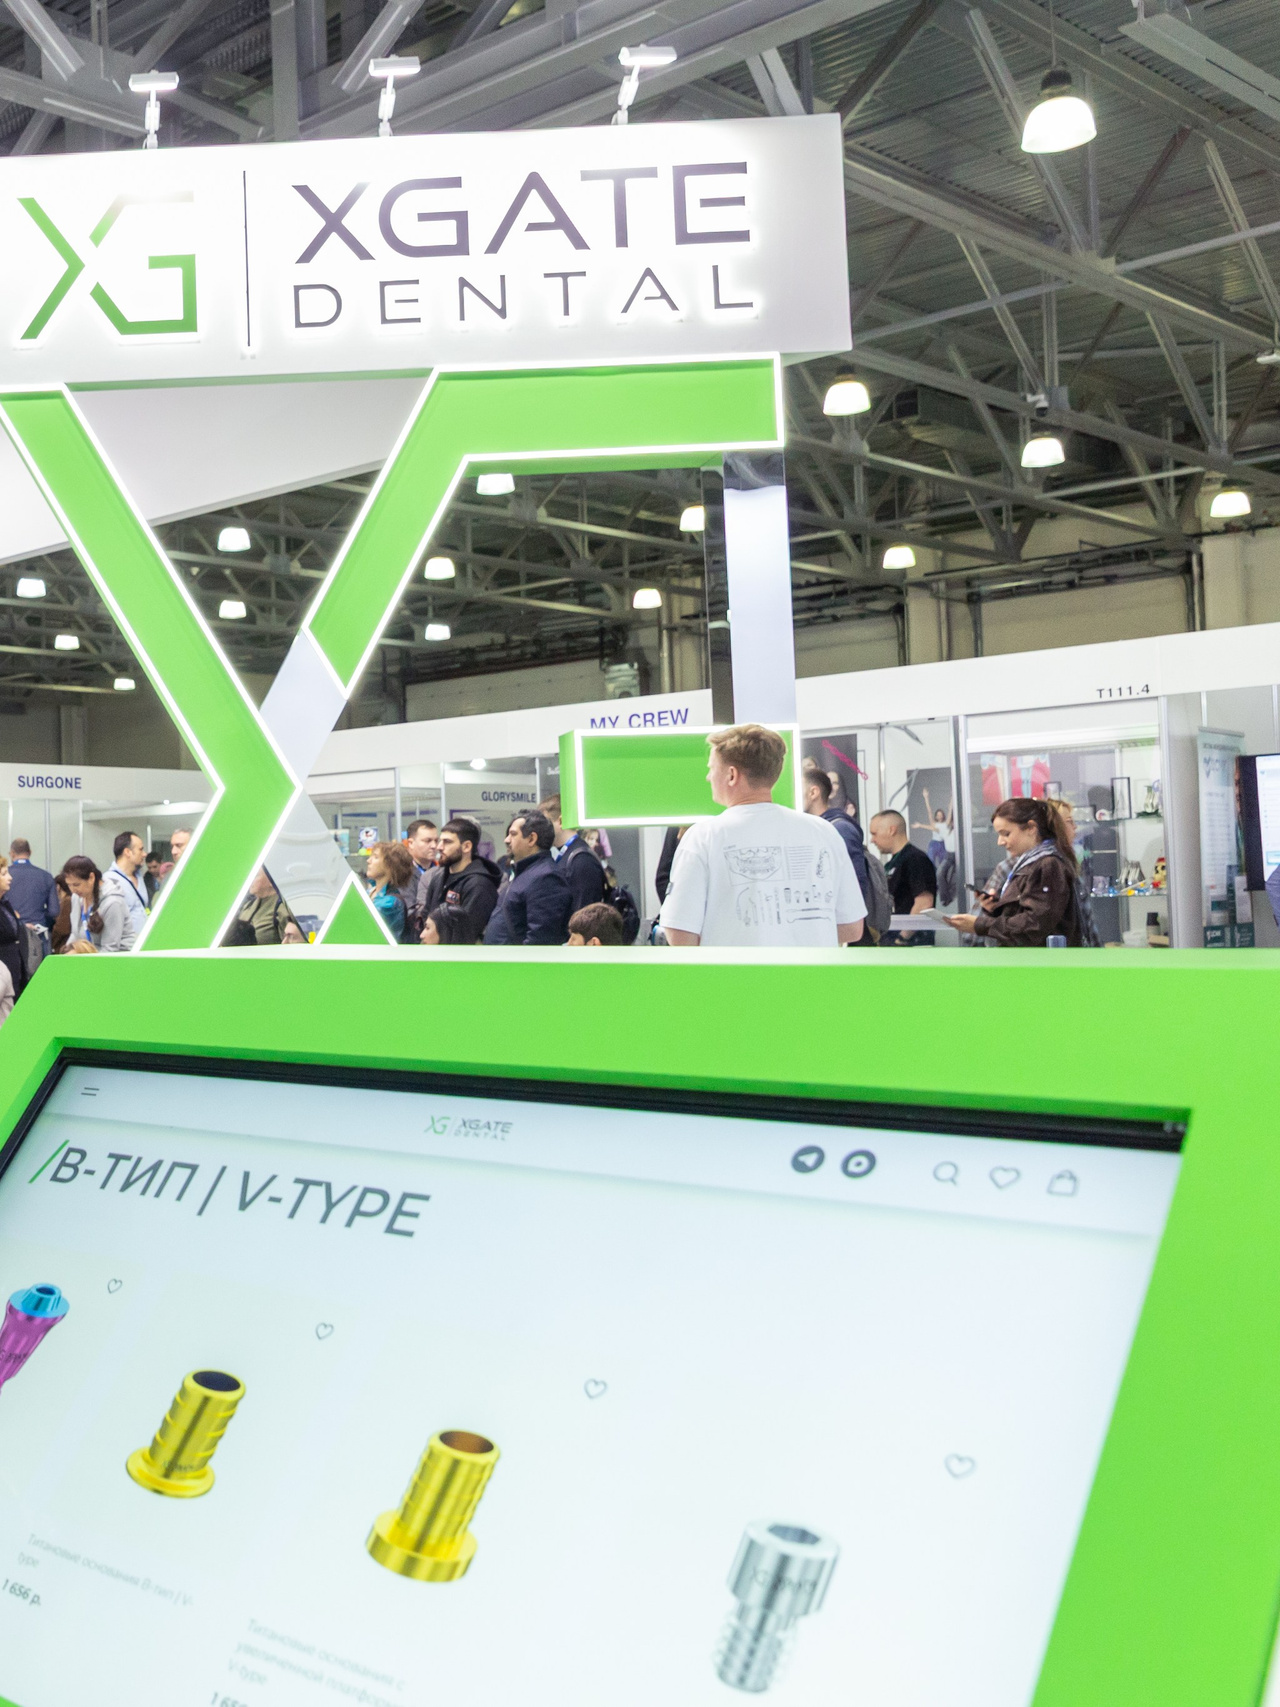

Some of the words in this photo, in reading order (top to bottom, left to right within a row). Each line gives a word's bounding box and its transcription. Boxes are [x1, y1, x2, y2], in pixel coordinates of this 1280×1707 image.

[293, 161, 751, 264] XGATE
[294, 265, 754, 329] DENTAL
[1096, 684, 1150, 699] T111.4
[590, 715, 619, 728] MY
[628, 708, 689, 728] CREW
[17, 774, 82, 790] SURGONE
[481, 791, 537, 803] GLORYSMILE
[453, 1128, 507, 1141] DENTAL
[458, 1117, 513, 1134] XGATE
[238, 1170, 431, 1238] V-TYPE
[9, 1582, 31, 1602] 656
